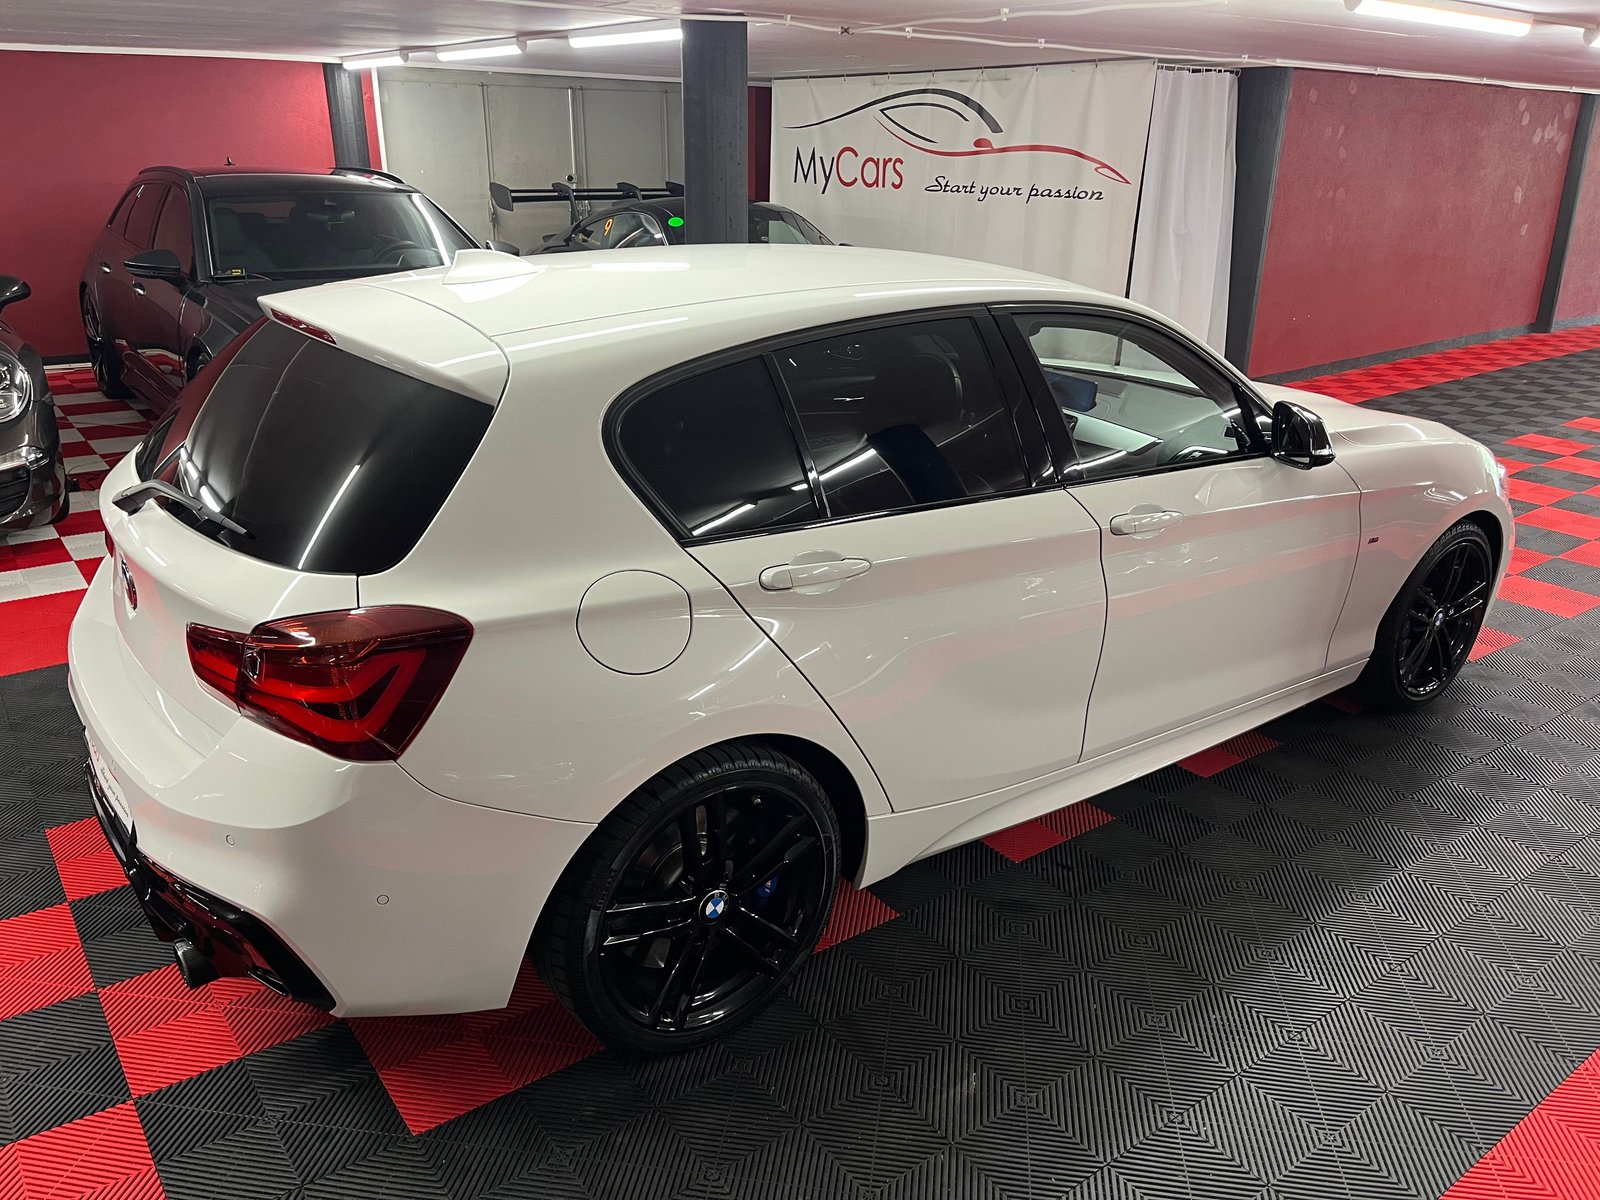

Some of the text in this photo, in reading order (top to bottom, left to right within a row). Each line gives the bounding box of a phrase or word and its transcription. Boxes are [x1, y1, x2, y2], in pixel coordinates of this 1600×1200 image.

[793, 145, 904, 195] MyCars
[924, 175, 1104, 204] Start your passion
[604, 218, 613, 236] 9
